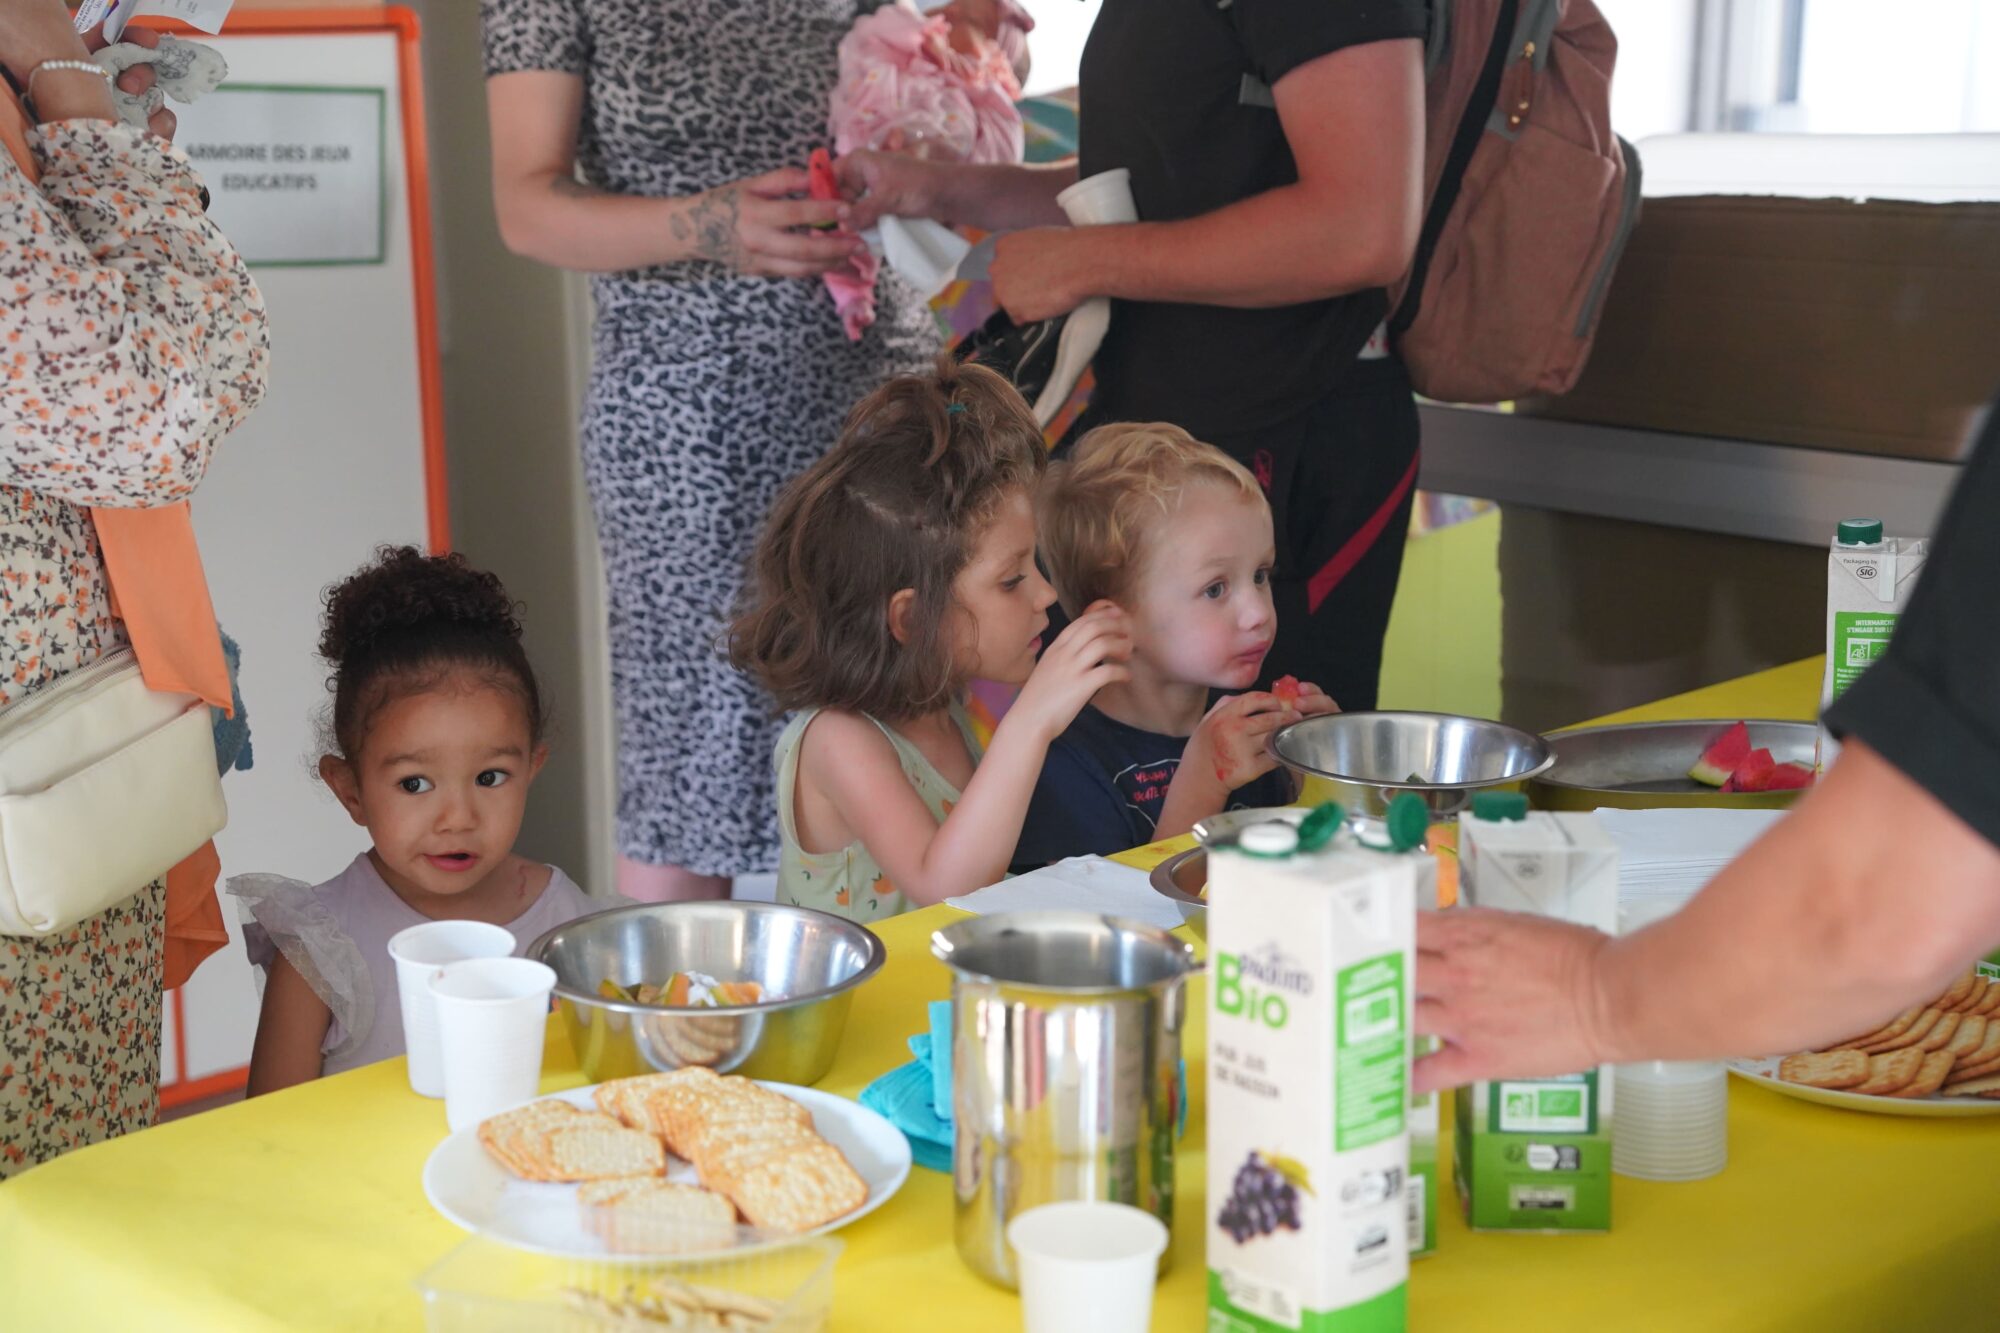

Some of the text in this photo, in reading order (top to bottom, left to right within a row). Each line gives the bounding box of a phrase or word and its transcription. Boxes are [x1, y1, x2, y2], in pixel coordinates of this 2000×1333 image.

[186, 143, 351, 161] ARMOIRE DES JEUX
[221, 173, 318, 190] EDUCATIFS
[1860, 568, 1873, 576] SIG
